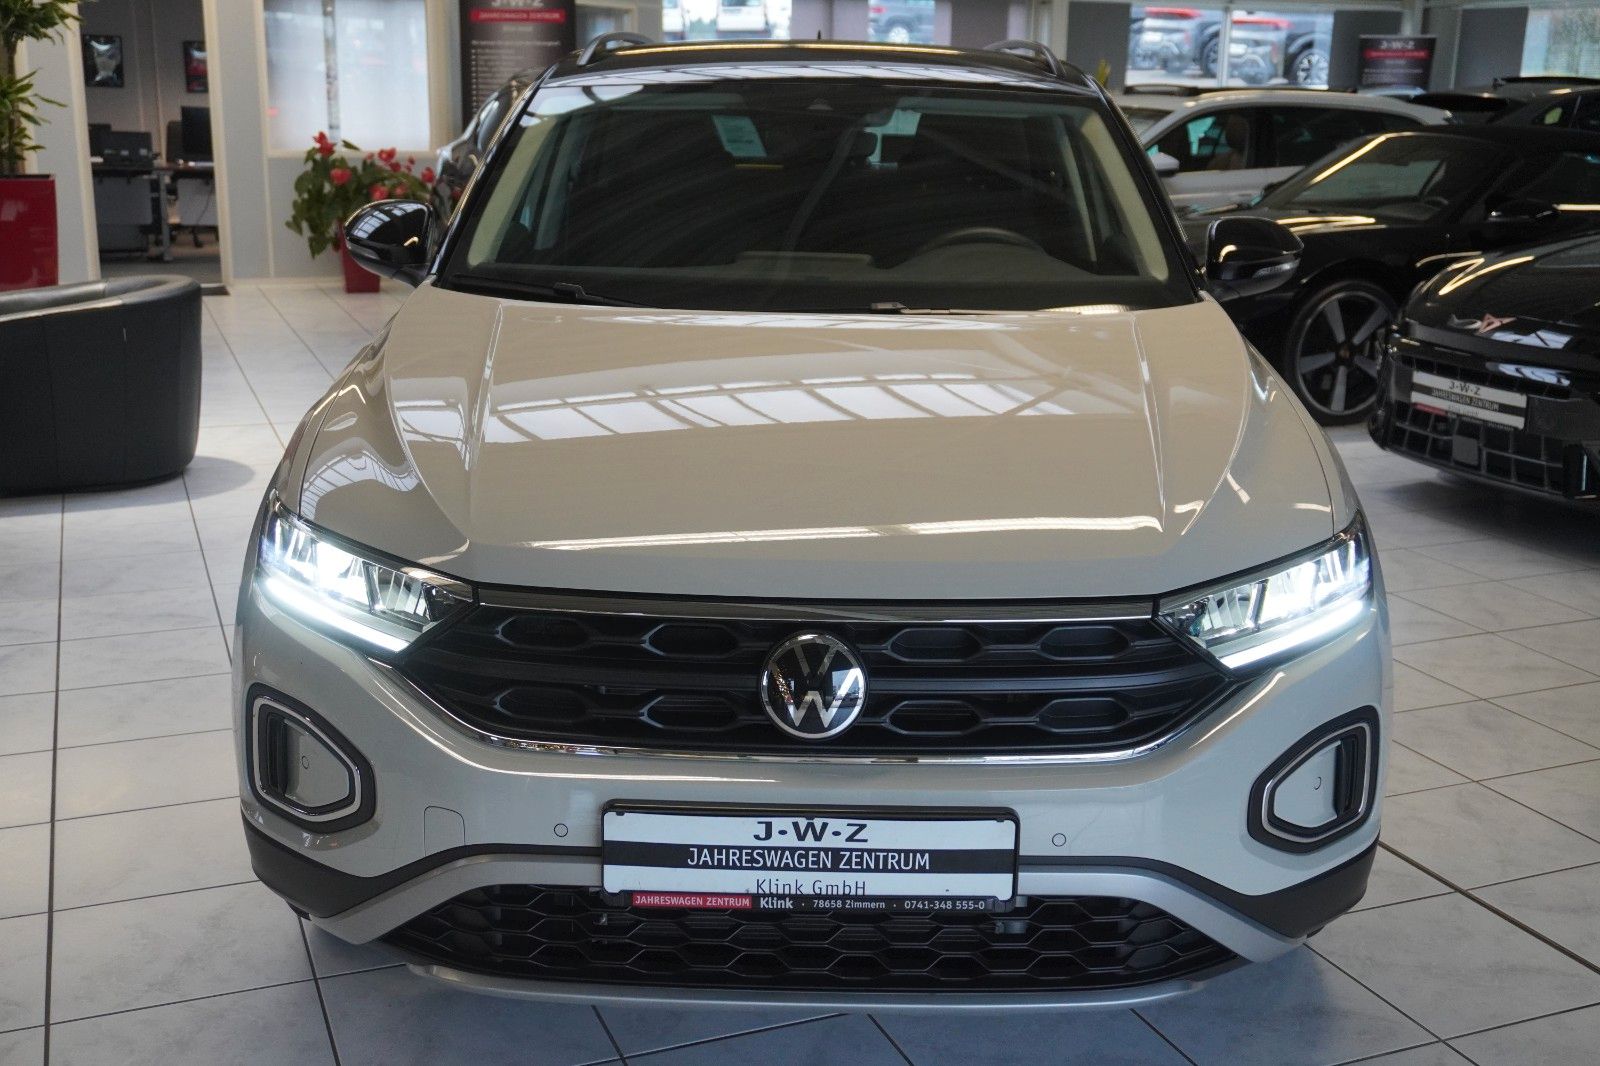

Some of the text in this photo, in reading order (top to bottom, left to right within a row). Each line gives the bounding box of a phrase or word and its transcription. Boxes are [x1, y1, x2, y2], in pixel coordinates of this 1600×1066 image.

[687, 847, 930, 870] JAHRESWAGEN ZENTRUM
[755, 878, 867, 896] Klink GmbH
[635, 895, 750, 907] JAHRESWAGEN ZENTRUM
[760, 897, 985, 910] Klink 78658 Zimmern 0741-348 555-0
